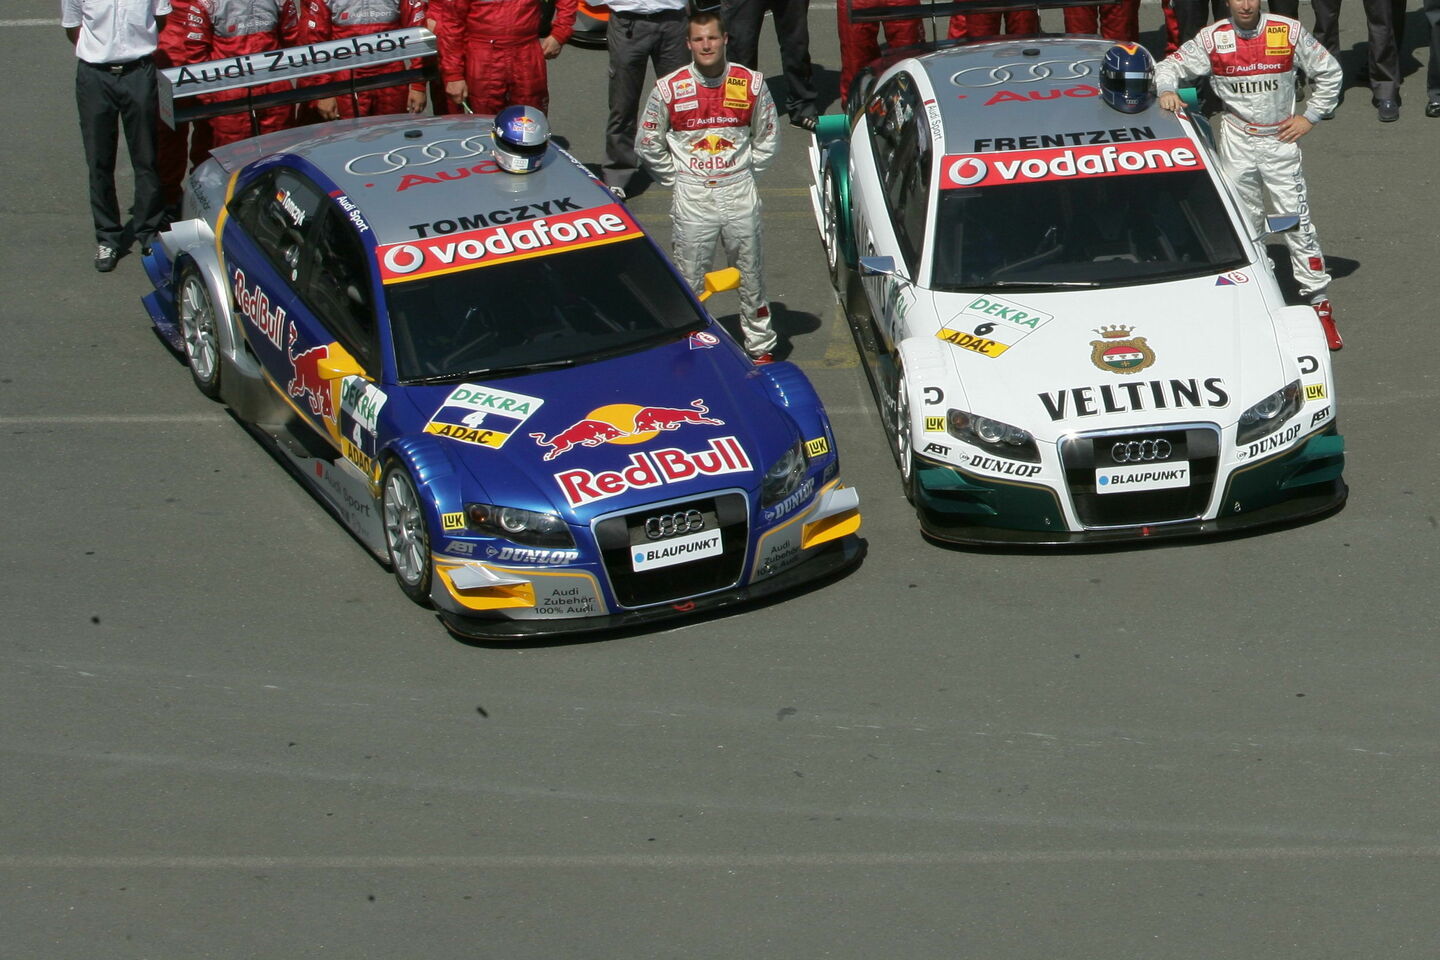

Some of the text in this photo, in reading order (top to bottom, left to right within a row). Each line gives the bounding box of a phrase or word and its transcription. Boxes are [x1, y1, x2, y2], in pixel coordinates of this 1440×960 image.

[1267, 26, 1287, 34] ADAC
[176, 33, 411, 88] Audi Zubehör
[1236, 62, 1281, 72] Audi Sport
[727, 77, 746, 87] ADAC
[1231, 79, 1279, 94] VELTINS
[697, 117, 715, 125] Audi
[974, 126, 1157, 153] FRENTZEN
[689, 157, 714, 170] Red
[993, 145, 1198, 181] vodafone
[337, 195, 369, 233] Audi Sport
[408, 196, 583, 239] TOMCZYK
[428, 212, 628, 265] vodafone
[969, 298, 1041, 330] DEKRA
[973, 322, 999, 337] 6
[945, 332, 996, 354] ADAC
[342, 378, 377, 426] DEKRA
[451, 388, 530, 415] DEKRA
[1037, 377, 1232, 422] VELTINS
[461, 411, 488, 429] 4
[1310, 405, 1331, 428] ABT
[438, 424, 494, 445] ADAC
[1248, 423, 1302, 458] DUNLOP
[922, 442, 952, 456] ABT
[556, 436, 752, 506] Red Bull
[969, 454, 1042, 478] DUNLOP
[1111, 469, 1187, 485] BLAUPUNKT
[774, 477, 815, 520] DUNLOP
[445, 540, 477, 555] ABT
[498, 546, 580, 565] DUNLOP
[646, 536, 719, 562] BLAUPUNKT
[552, 588, 579, 596] Audi
